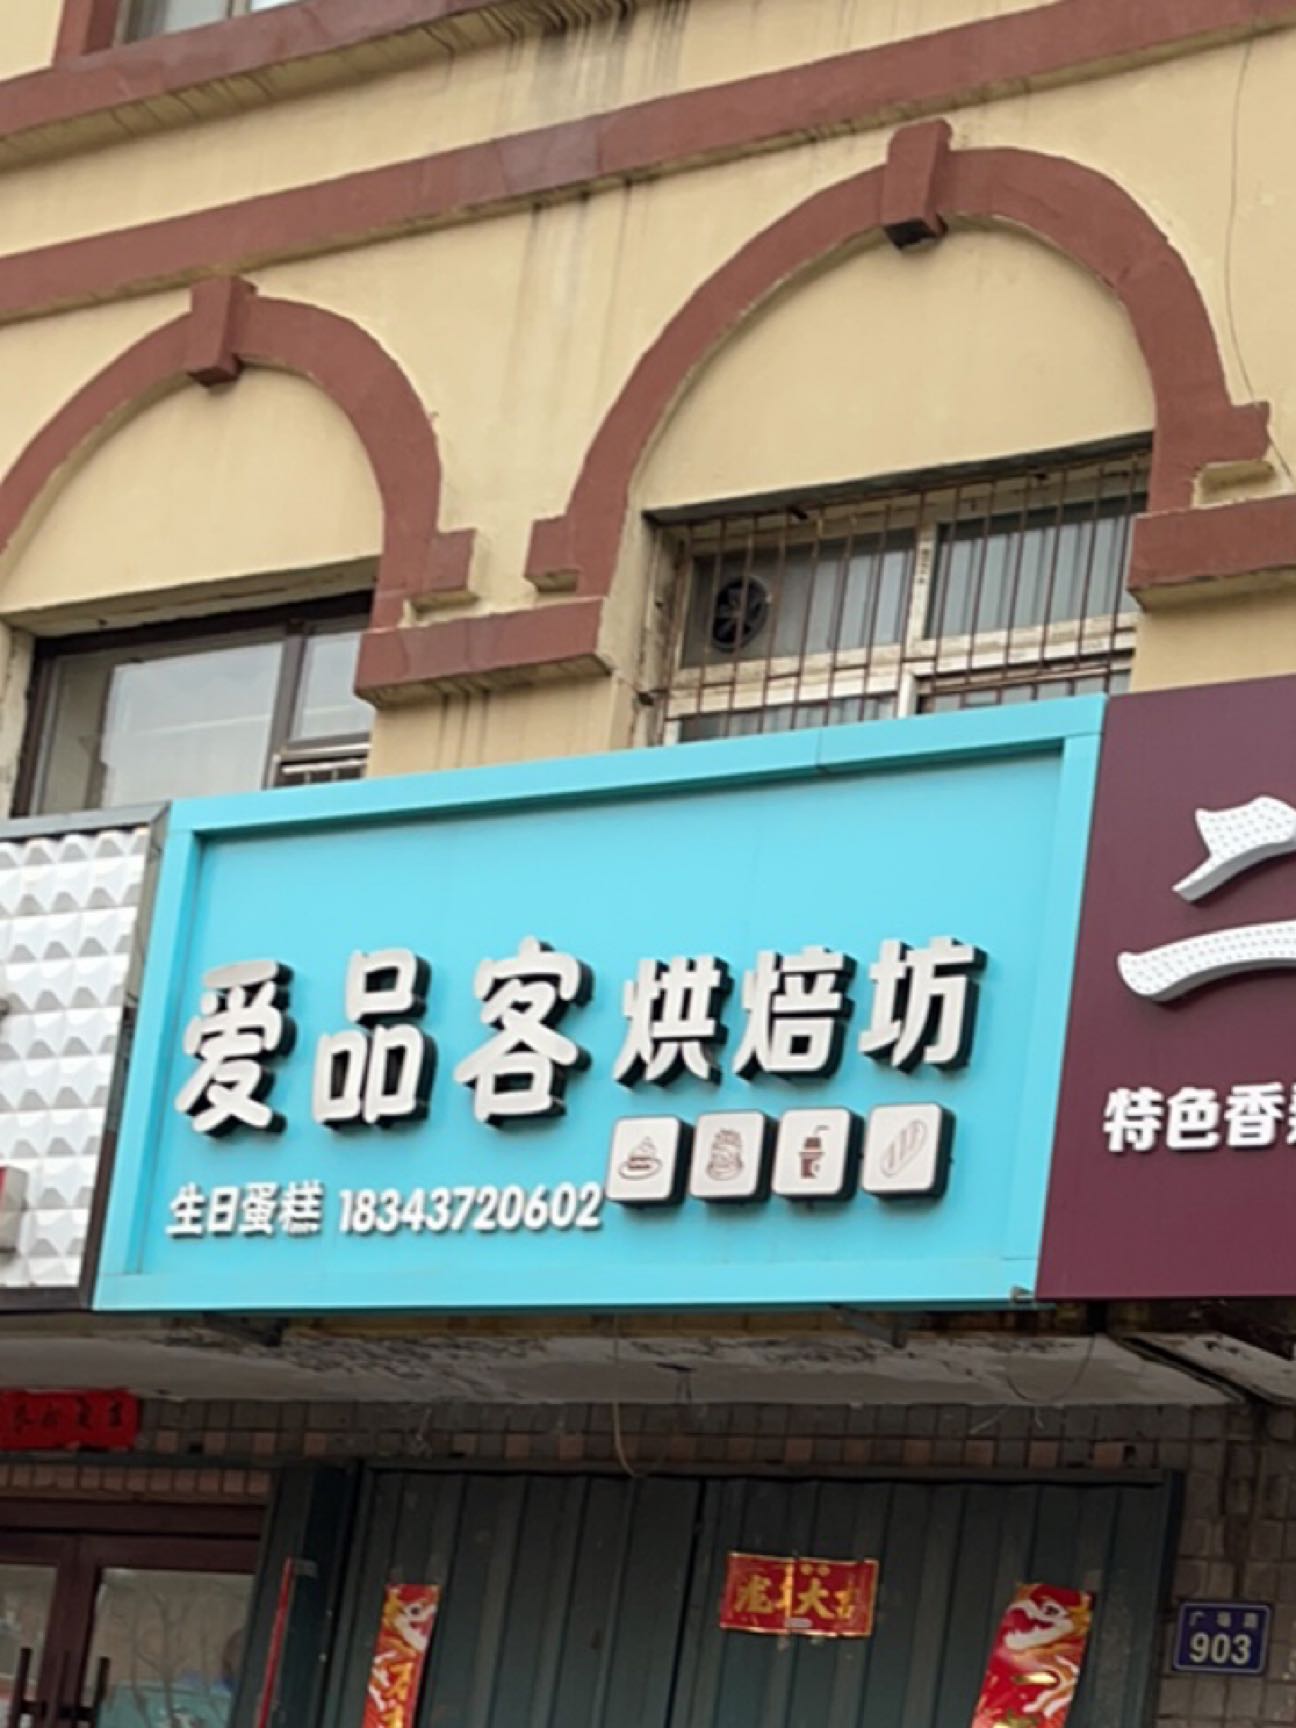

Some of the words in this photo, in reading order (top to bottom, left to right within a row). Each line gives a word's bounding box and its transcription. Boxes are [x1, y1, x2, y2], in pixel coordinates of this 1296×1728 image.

[167, 1181, 323, 1239] 生日蛋糕
[338, 1183, 601, 1234] 18343720602
[1188, 1631, 1252, 1665] 903
